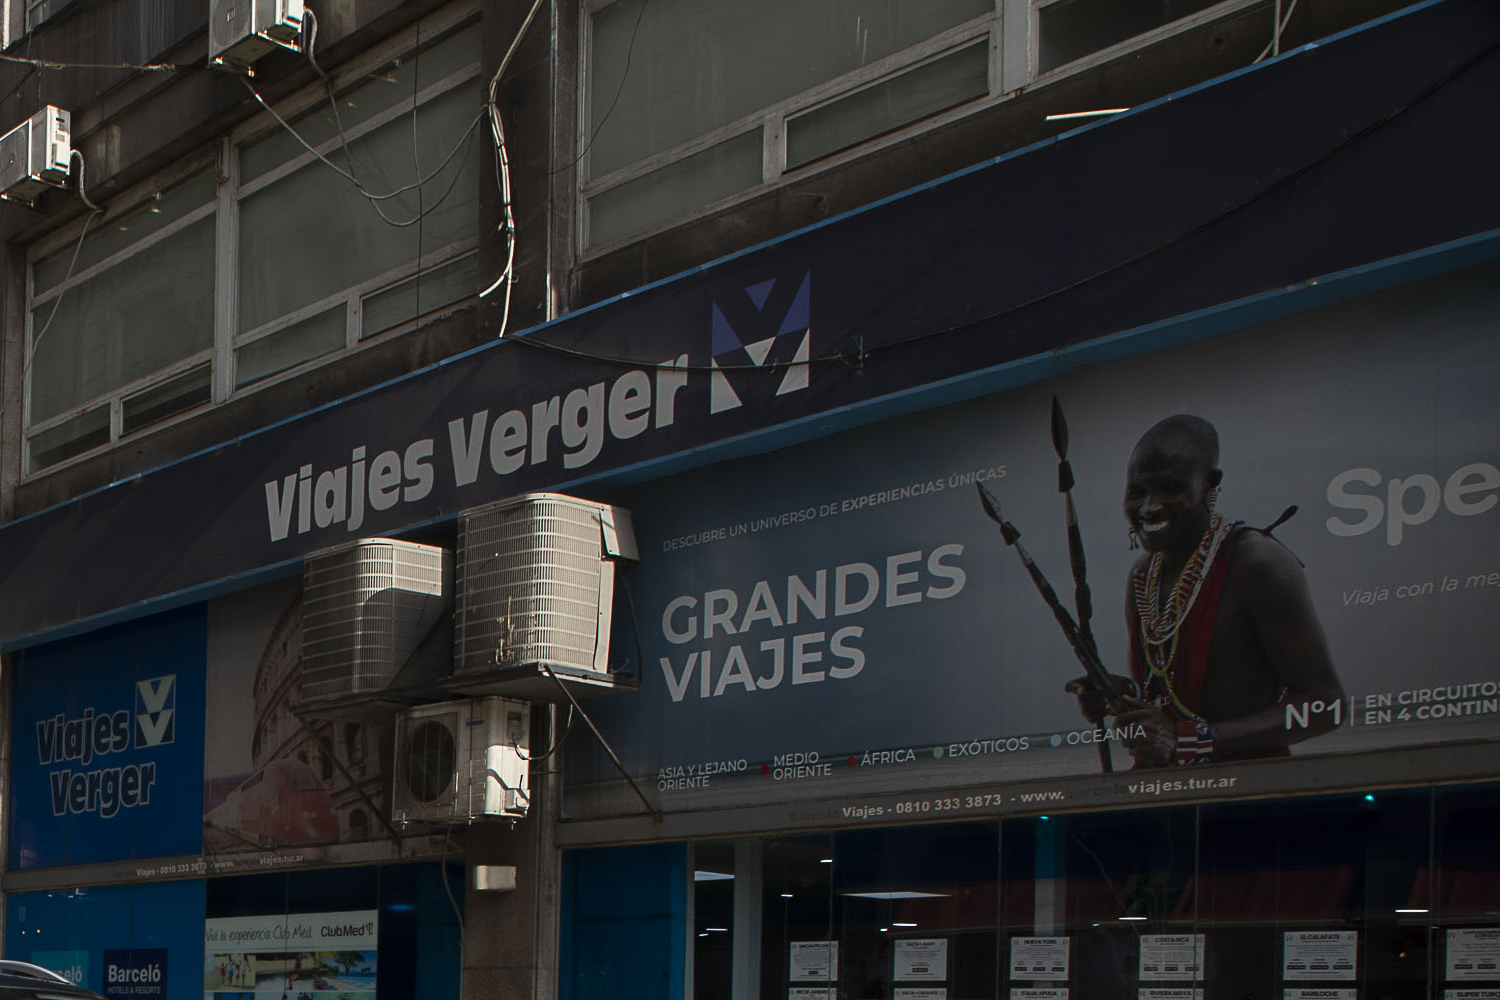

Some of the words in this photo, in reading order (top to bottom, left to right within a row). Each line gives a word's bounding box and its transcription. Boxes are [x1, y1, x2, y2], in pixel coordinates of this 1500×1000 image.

[264, 438, 435, 543] Viajes
[448, 354, 689, 487] Verger
[662, 525, 727, 553] DESCUBRE
[729, 522, 748, 538] UN
[750, 507, 817, 533] UNIVERSO
[819, 501, 839, 518] DE
[841, 478, 945, 513] EXPERIENCIAS
[948, 464, 1008, 489] ÚNICAS
[661, 543, 967, 646] GRANDES
[1342, 588, 1389, 606] Viaja
[1395, 582, 1434, 599] con
[1440, 576, 1459, 592] la
[659, 626, 867, 703] VIAJES
[1365, 692, 1392, 709] EN
[1364, 709, 1392, 726] EN
[1397, 708, 1412, 722] 4
[36, 708, 131, 766] Viajes
[1067, 722, 1147, 747] OCEANÍA
[860, 746, 916, 767] ÁFRICA
[948, 736, 1029, 758] EXÓTICOS
[657, 765, 685, 780] ASIA
[686, 764, 696, 777] Y
[697, 759, 748, 777] LEJANO
[773, 751, 820, 767] MEDIO
[772, 763, 832, 781] ORIENTE
[49, 761, 156, 819] Verger
[657, 775, 710, 792] ORIENTE
[842, 805, 884, 820] Viajes
[895, 801, 930, 814] 0810
[934, 798, 961, 811] 333
[965, 794, 1002, 808] 3873
[1020, 791, 1065, 803] www.
[1127, 776, 1237, 796] viajes.tur.ar
[136, 867, 156, 877] Viajes
[160, 864, 177, 875] 0810
[177, 864, 190, 874] 333
[220, 928, 228, 941] la
[229, 927, 271, 944] experiencia
[273, 925, 290, 940] Club
[293, 923, 312, 939] Med
[108, 964, 161, 983] Barceló
